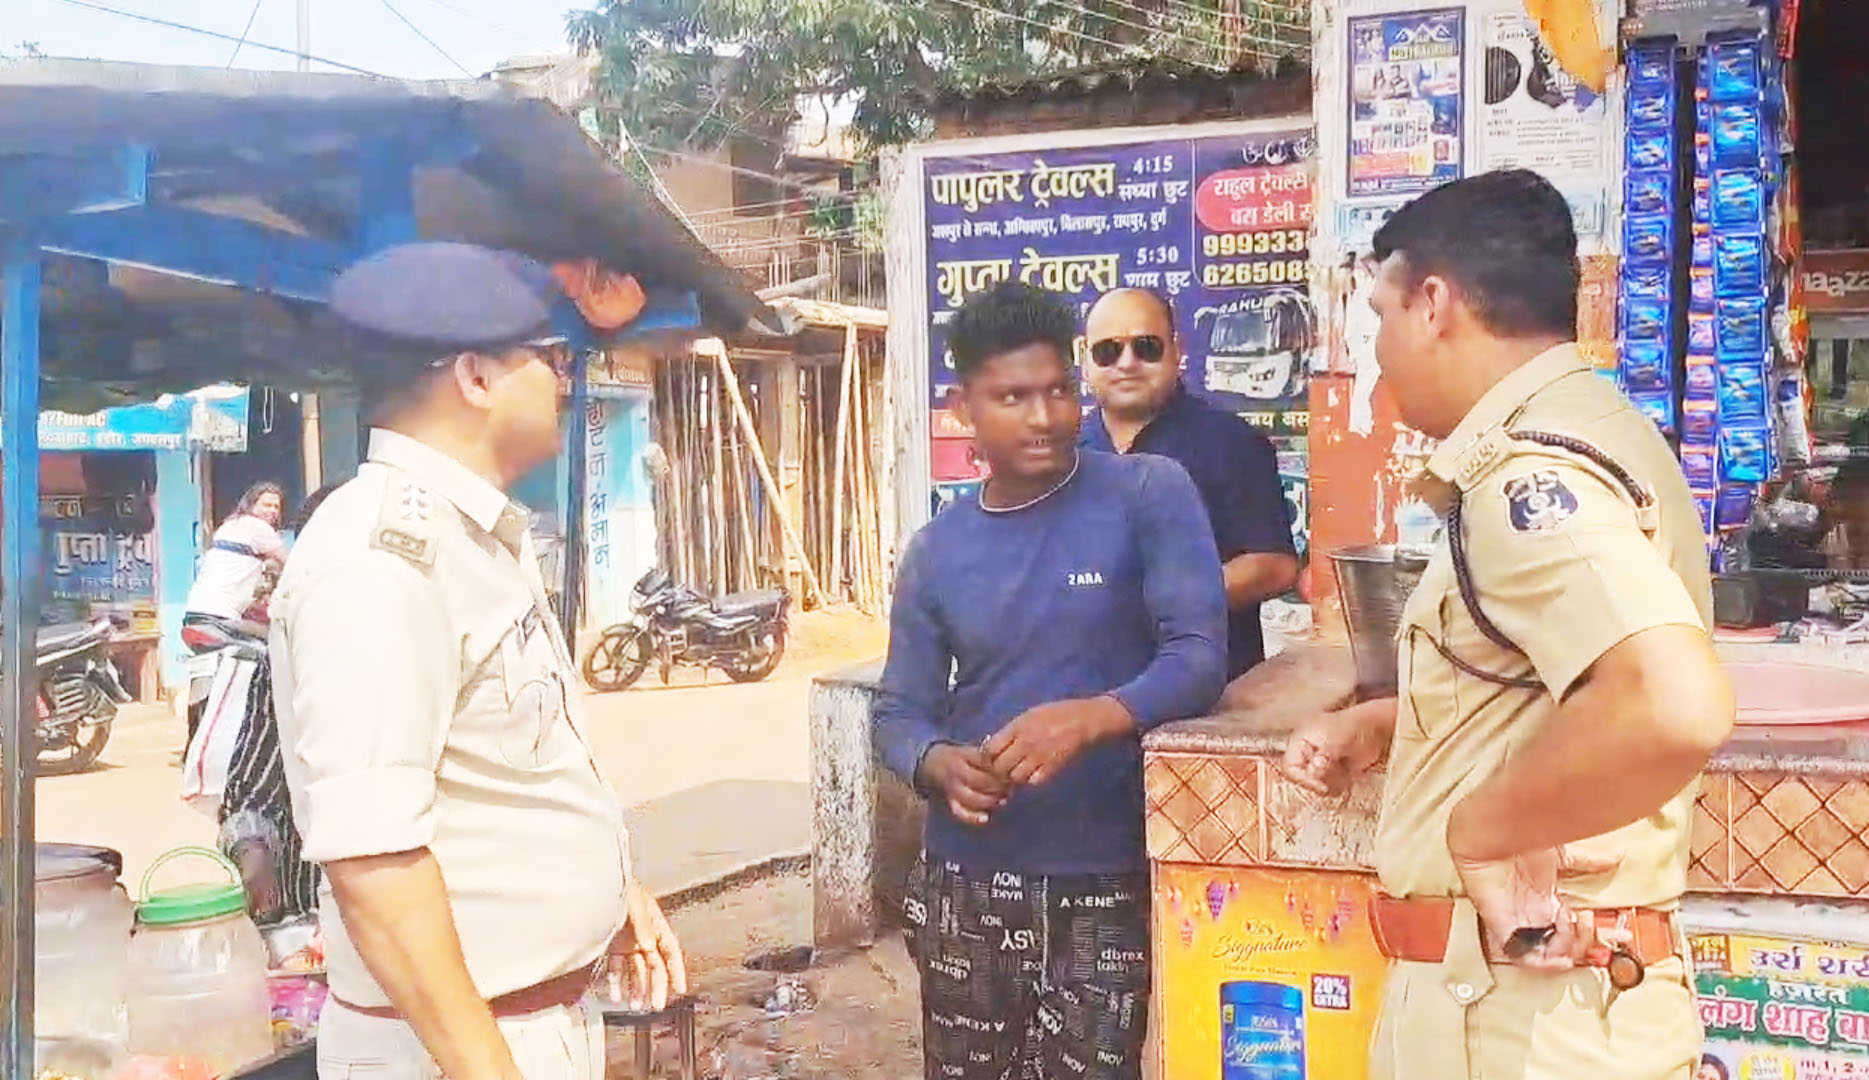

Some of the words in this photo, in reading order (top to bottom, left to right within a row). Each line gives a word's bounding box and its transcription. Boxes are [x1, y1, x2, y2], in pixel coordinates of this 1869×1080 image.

[1133, 155, 1173, 175] 4:15
[931, 169, 1025, 213] पापुलर
[1030, 159, 1116, 208] ट्रेवल्स
[1214, 176, 1255, 201] राहुल
[1263, 201, 1294, 225] डेली
[1137, 246, 1178, 265] 5:30
[936, 259, 1012, 307] गुप्ता
[1219, 294, 1264, 314] RAHU
[1313, 975, 1348, 995] 20%
[1313, 994, 1348, 1008] EXTRA
[1697, 984, 1759, 1032] लंग
[1763, 1000, 1832, 1045] शाह
